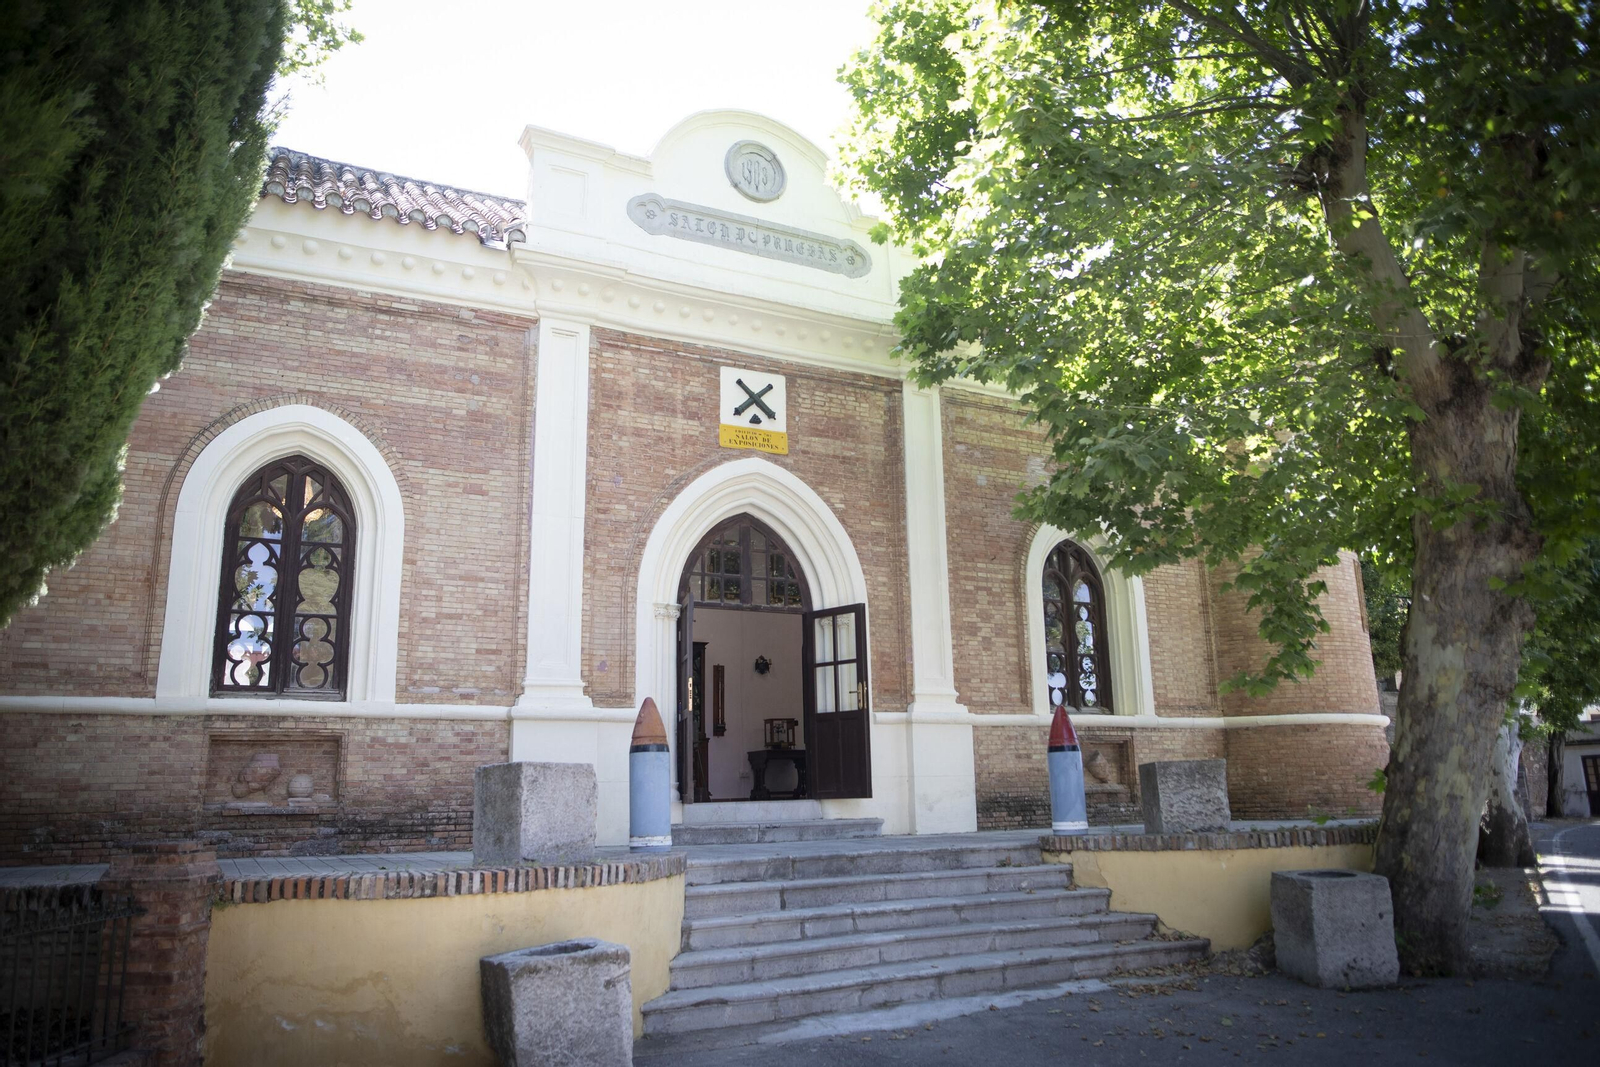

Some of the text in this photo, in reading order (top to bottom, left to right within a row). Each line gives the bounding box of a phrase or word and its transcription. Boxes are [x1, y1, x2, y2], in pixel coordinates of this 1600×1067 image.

[668, 212, 730, 240] SALON
[762, 233, 837, 262] PRUEBAS
[729, 438, 779, 449] EXPOSICIONES
